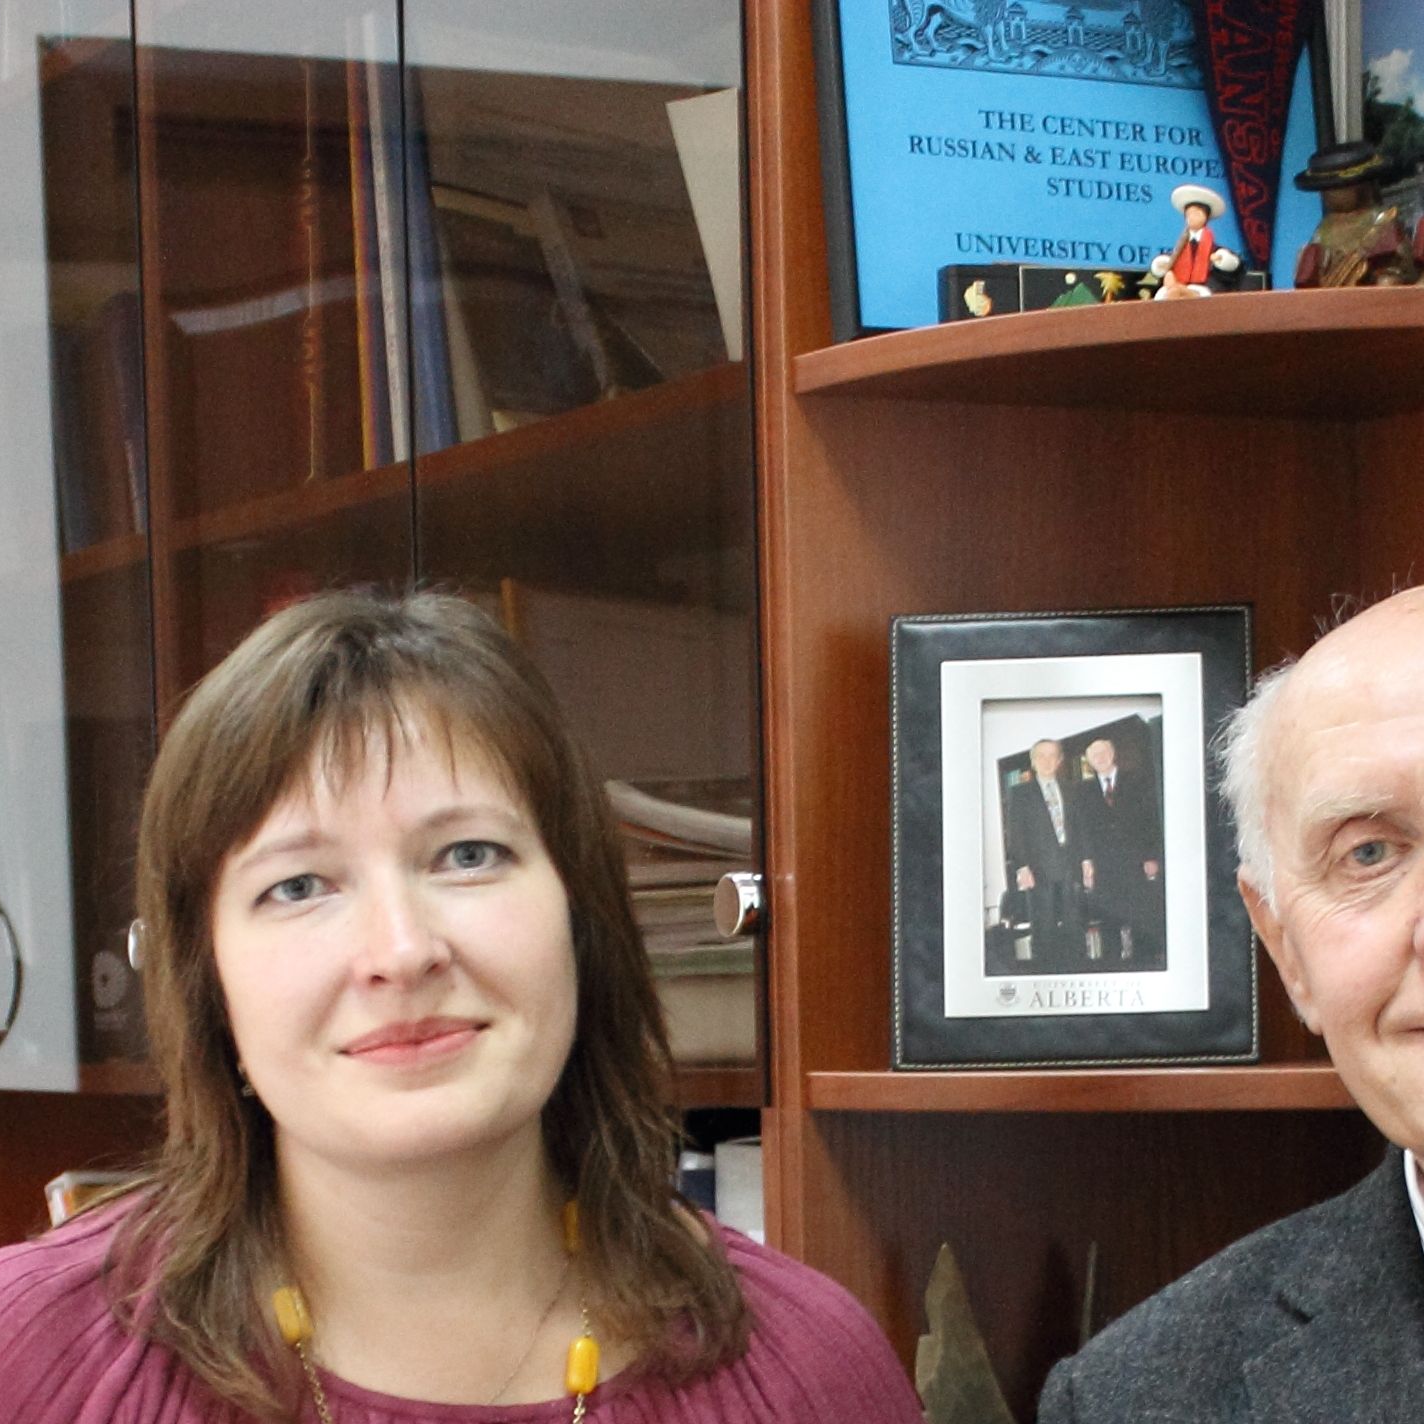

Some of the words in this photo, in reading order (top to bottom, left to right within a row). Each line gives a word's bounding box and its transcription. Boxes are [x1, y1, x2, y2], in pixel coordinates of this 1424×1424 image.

[978, 109, 1035, 134] THE
[1042, 115, 1146, 143] CENTER
[1154, 124, 1203, 147] FOR
[1206, 0, 1272, 261] ANSAS
[909, 135, 1016, 162] RUSSIAN
[1024, 145, 1042, 165] &
[1051, 147, 1112, 170] EAST
[1119, 152, 1226, 180] EUROPE
[1047, 177, 1153, 204] STUDIES
[956, 232, 1111, 263] UNIVERSITY
[1118, 244, 1151, 265] OF
[1029, 989, 1144, 1008] ALBERTA
